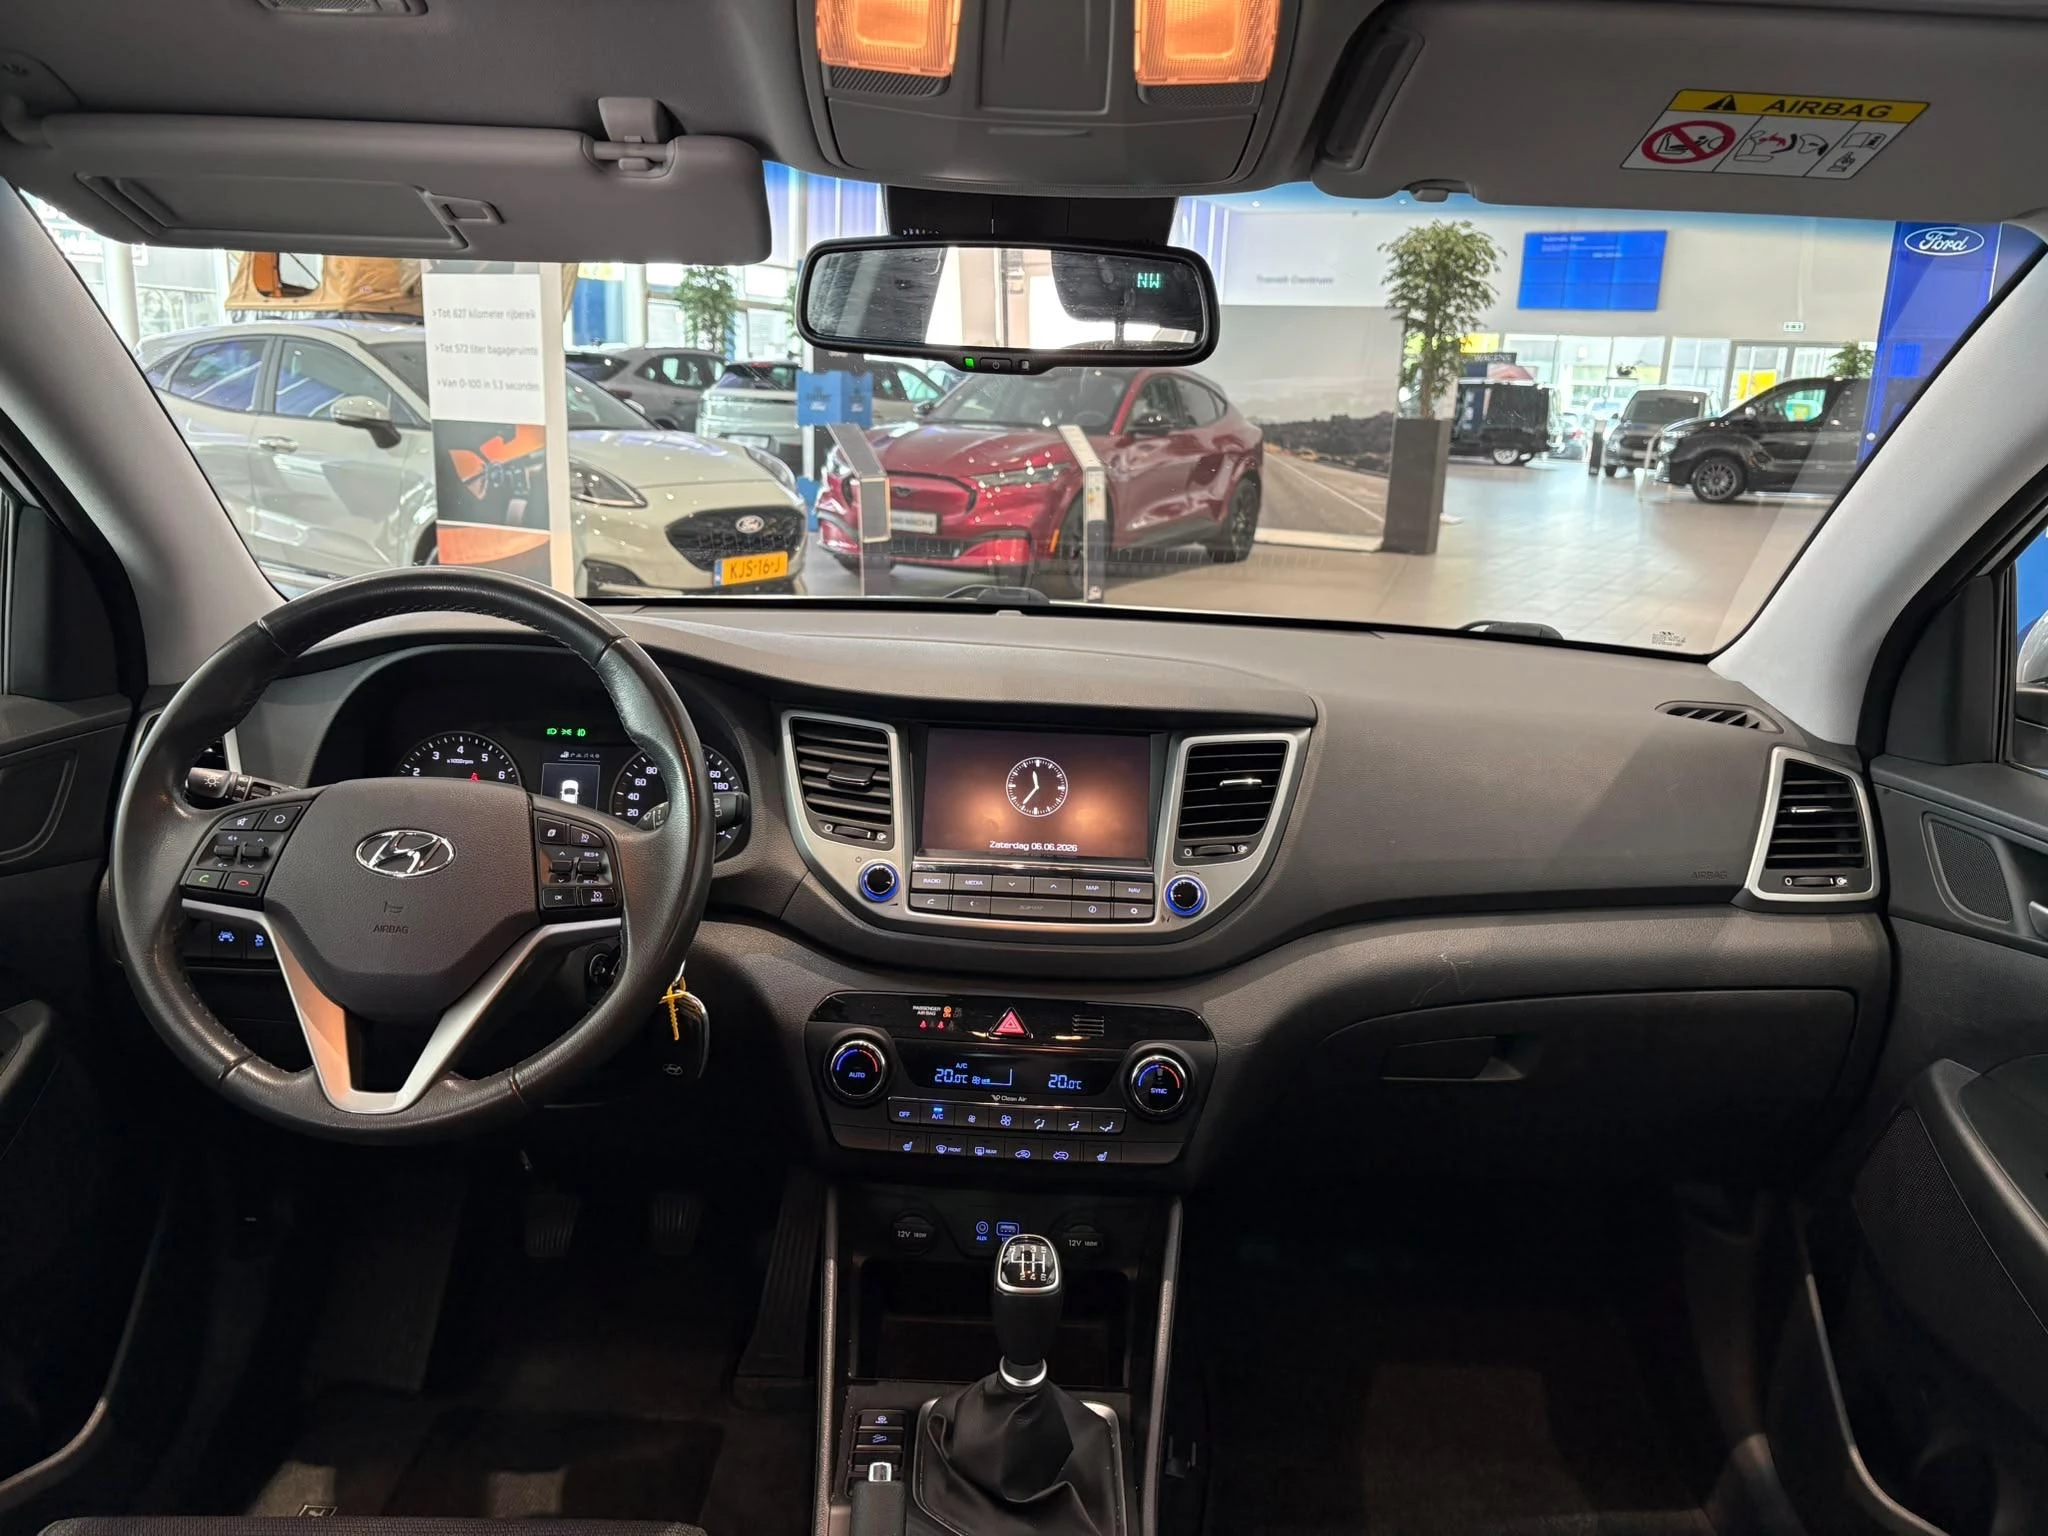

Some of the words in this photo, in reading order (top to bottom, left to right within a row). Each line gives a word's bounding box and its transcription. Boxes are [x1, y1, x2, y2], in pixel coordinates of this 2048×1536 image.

[1762, 100, 1894, 119] AIRBAG
[1919, 230, 1968, 252] Ford
[1137, 272, 1160, 289] NW
[457, 746, 464, 754] 4
[432, 751, 440, 760] 3
[481, 753, 489, 762] 5
[412, 768, 421, 777] 2
[498, 771, 506, 779] 6
[646, 767, 658, 775] 80
[634, 778, 647, 786] 60
[627, 792, 640, 801] 40
[627, 808, 639, 817] 20
[989, 840, 1029, 851] Zaterdag
[1031, 843, 1078, 852] 06.06.2026
[372, 924, 409, 934] AIRBAG
[897, 1230, 911, 1238] 12V
[1068, 1239, 1082, 1247] 12V
